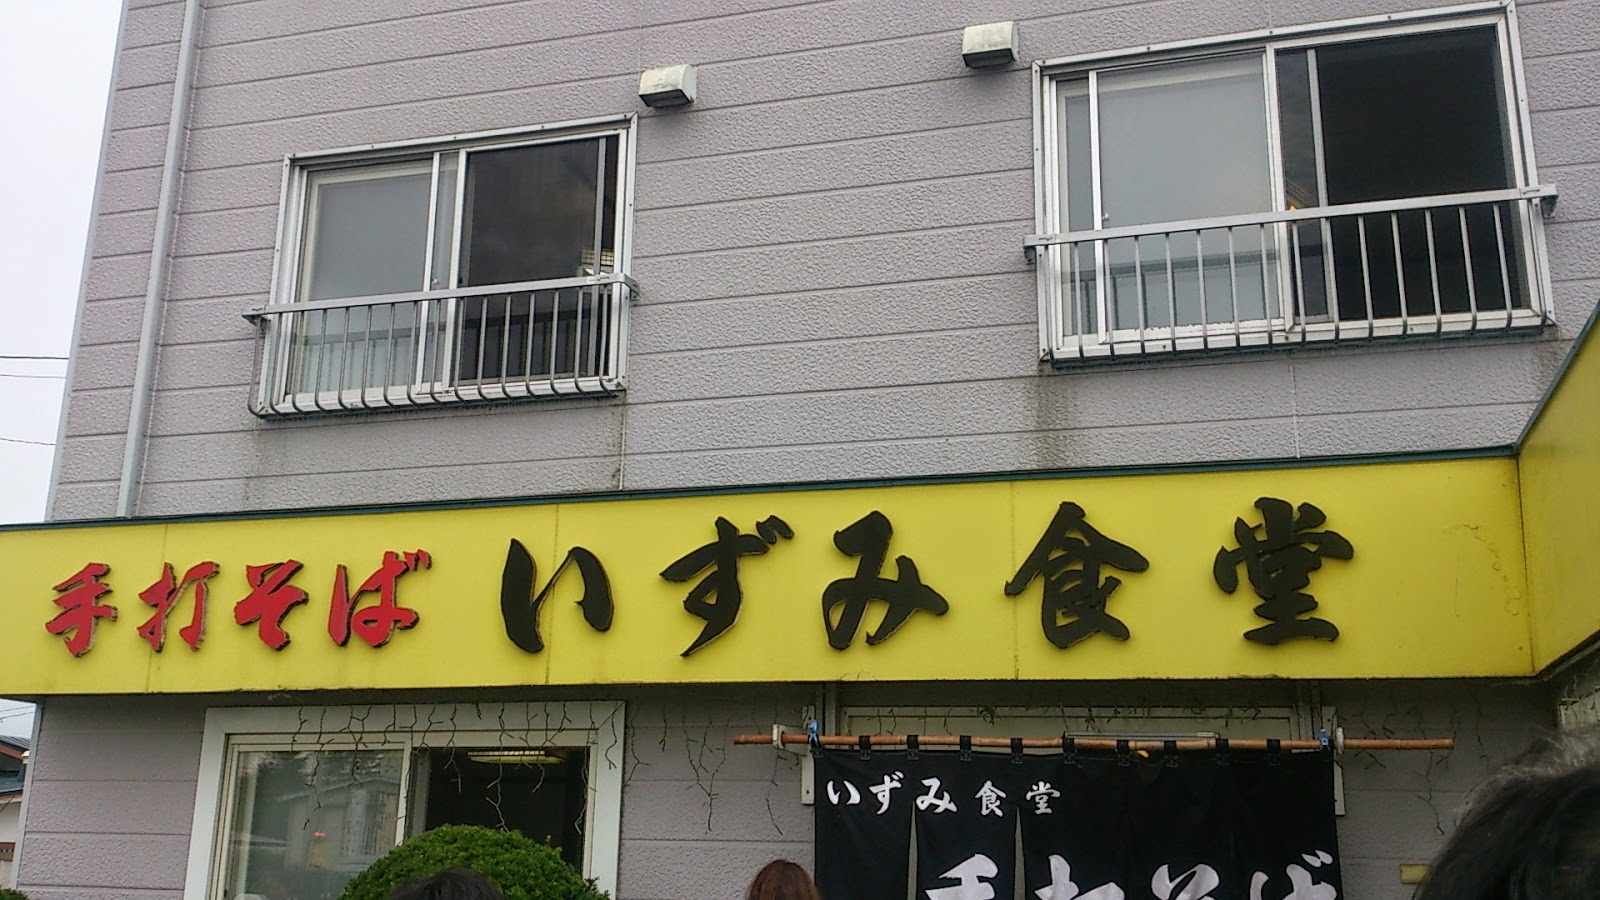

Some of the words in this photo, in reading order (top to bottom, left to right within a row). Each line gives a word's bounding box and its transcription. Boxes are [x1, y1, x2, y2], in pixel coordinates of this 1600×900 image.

[46, 550, 432, 657] 手打そば
[501, 497, 1355, 659] いずみ食堂
[826, 771, 1062, 818] いずみ食堂
